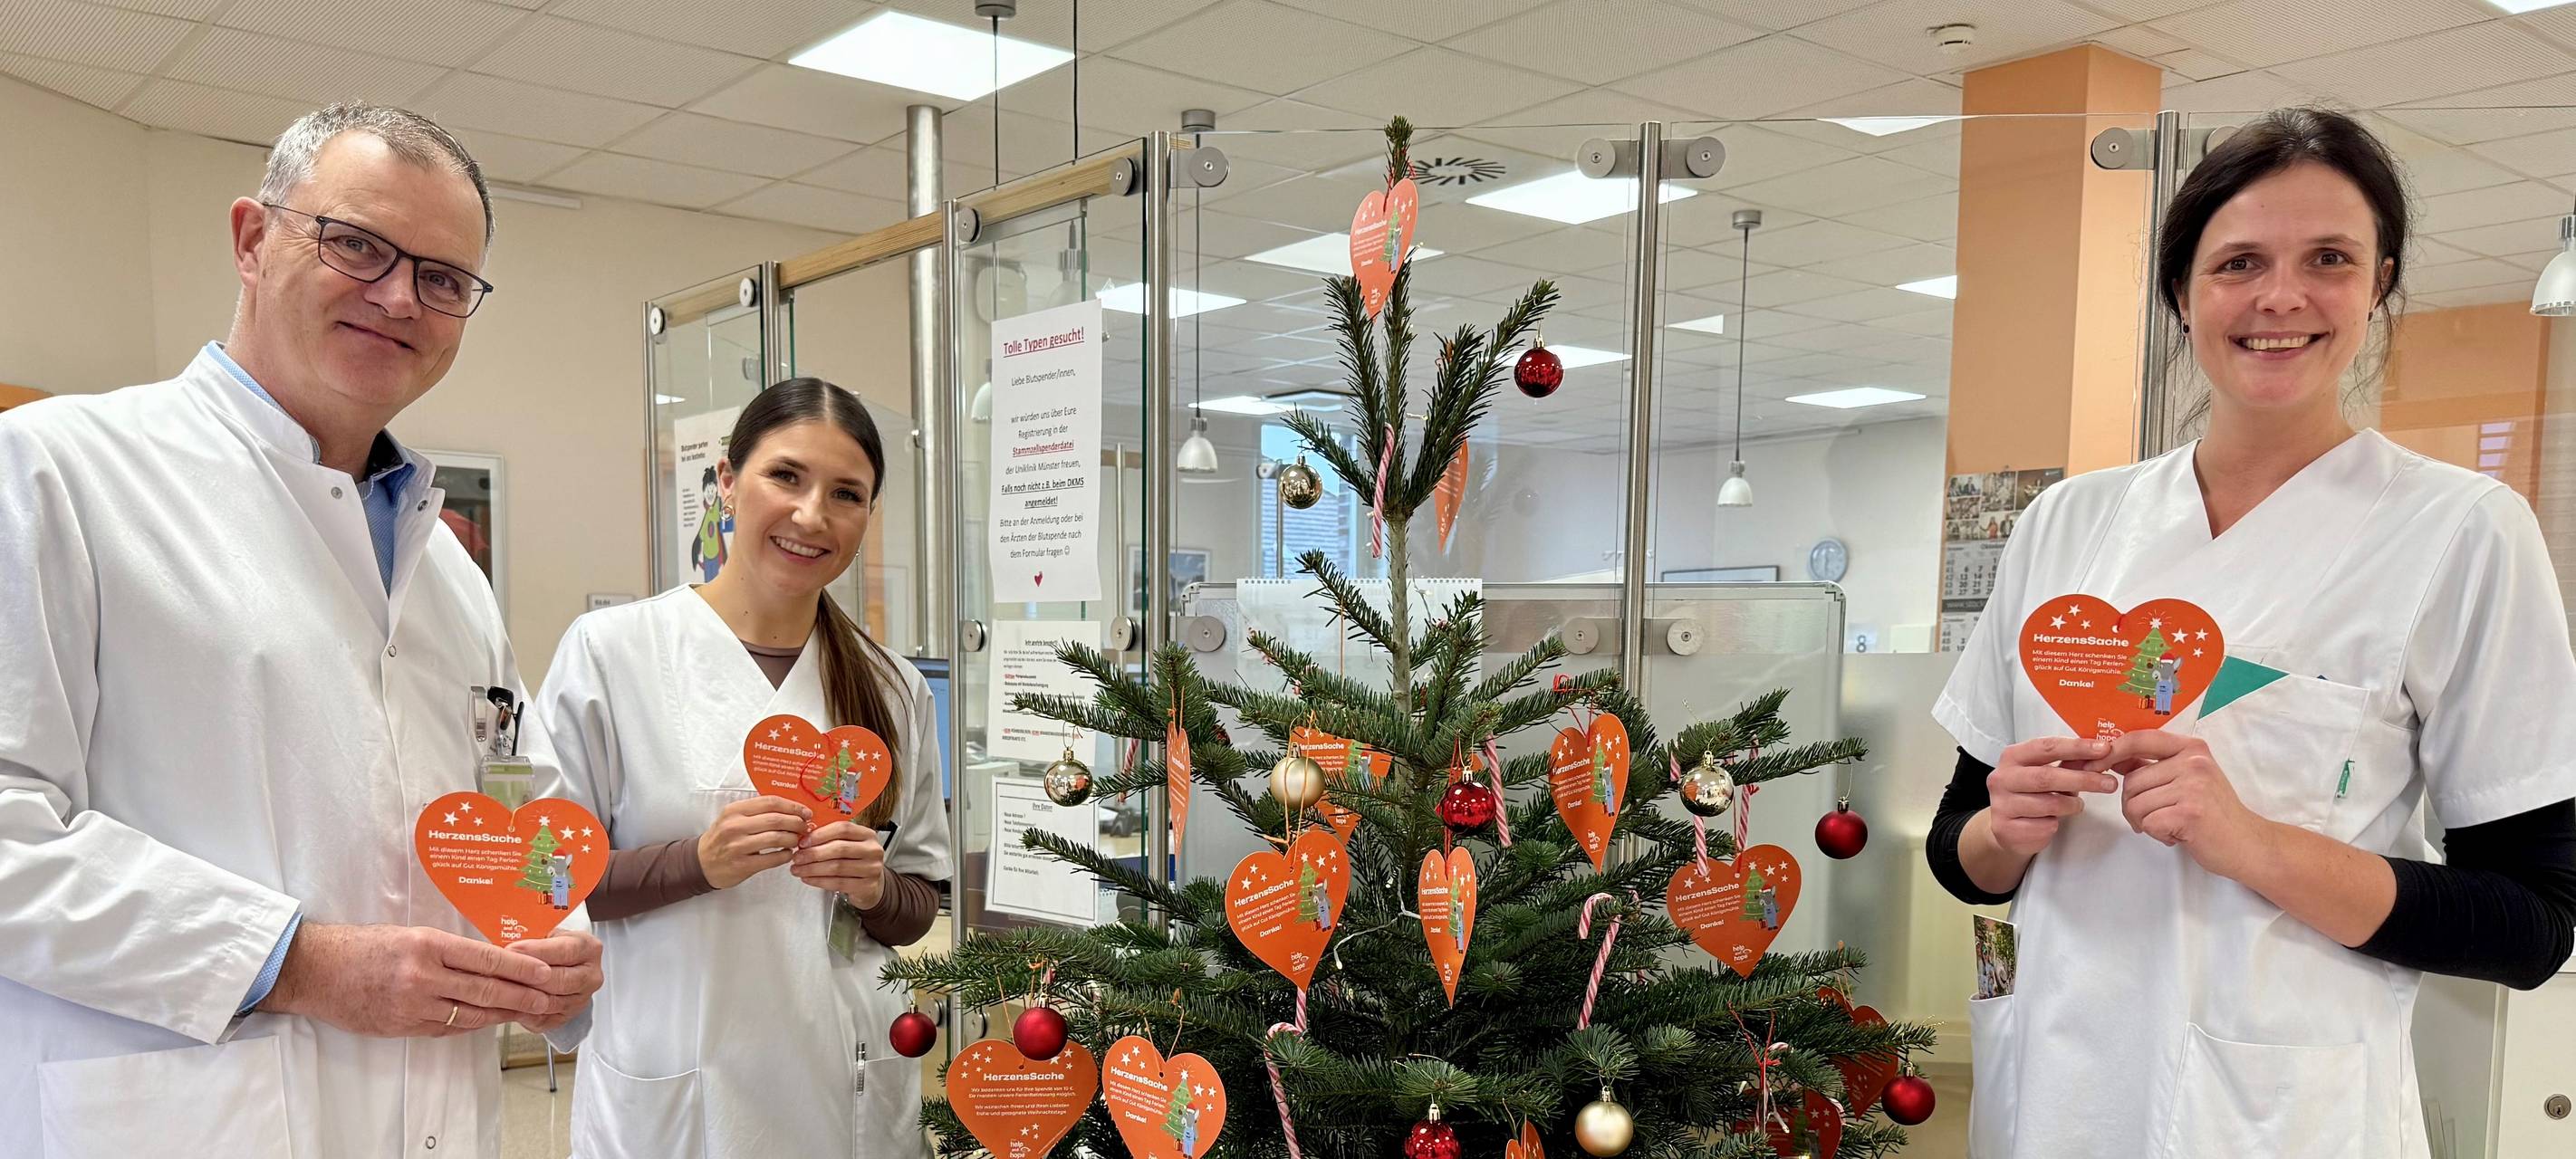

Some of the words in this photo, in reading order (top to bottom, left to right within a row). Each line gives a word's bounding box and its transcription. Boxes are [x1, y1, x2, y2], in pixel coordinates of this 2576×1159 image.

[1004, 340, 1022, 354] Tolle
[1024, 338, 1047, 351] Typen
[1050, 326, 1084, 348] gesucht!
[1012, 377, 1024, 386] Liebe
[1021, 412, 1039, 422] würden
[1051, 408, 1062, 417] über
[1064, 407, 1076, 416] Eure
[1019, 428, 1052, 439] Registrierung
[1059, 424, 1068, 433] der
[1015, 464, 1036, 474] Uniklinik
[1038, 462, 1060, 470] Münster
[1002, 484, 1013, 493] Falls
[1014, 484, 1026, 492] noch
[1028, 482, 1041, 490] nicht
[1053, 479, 1065, 487] beim
[1067, 477, 1084, 486] DKMS
[1000, 519, 1011, 527] Bitte
[1021, 517, 1029, 525] der
[1030, 515, 1060, 524] Anmeldung
[1061, 514, 1073, 522] oder
[1074, 513, 1083, 522] bei
[1038, 531, 1067, 541] Blutspende
[1069, 530, 1081, 538] nach
[1023, 548, 1045, 557] Formular
[1046, 548, 1063, 558] fragen
[2033, 634, 2129, 647] HerzensSache
[2060, 679, 2094, 688] Danke!
[2098, 721, 2116, 729] help
[2096, 733, 2117, 742] hope
[772, 780, 797, 789] Danke!
[428, 830, 522, 843] HerzensSache
[458, 876, 494, 885] Danke!
[1235, 880, 1293, 908] HerzensSache
[1676, 883, 1739, 902] HerzensSache
[501, 917, 517, 926] help
[1700, 920, 1725, 929] Danke!
[501, 931, 522, 939] hope
[1260, 924, 1282, 937] Danke!
[1293, 963, 1306, 972] hope
[984, 1072, 1064, 1081] HerzensSache
[1110, 1066, 1168, 1091] HerzensSache
[1125, 1111, 1147, 1123] Danke!
